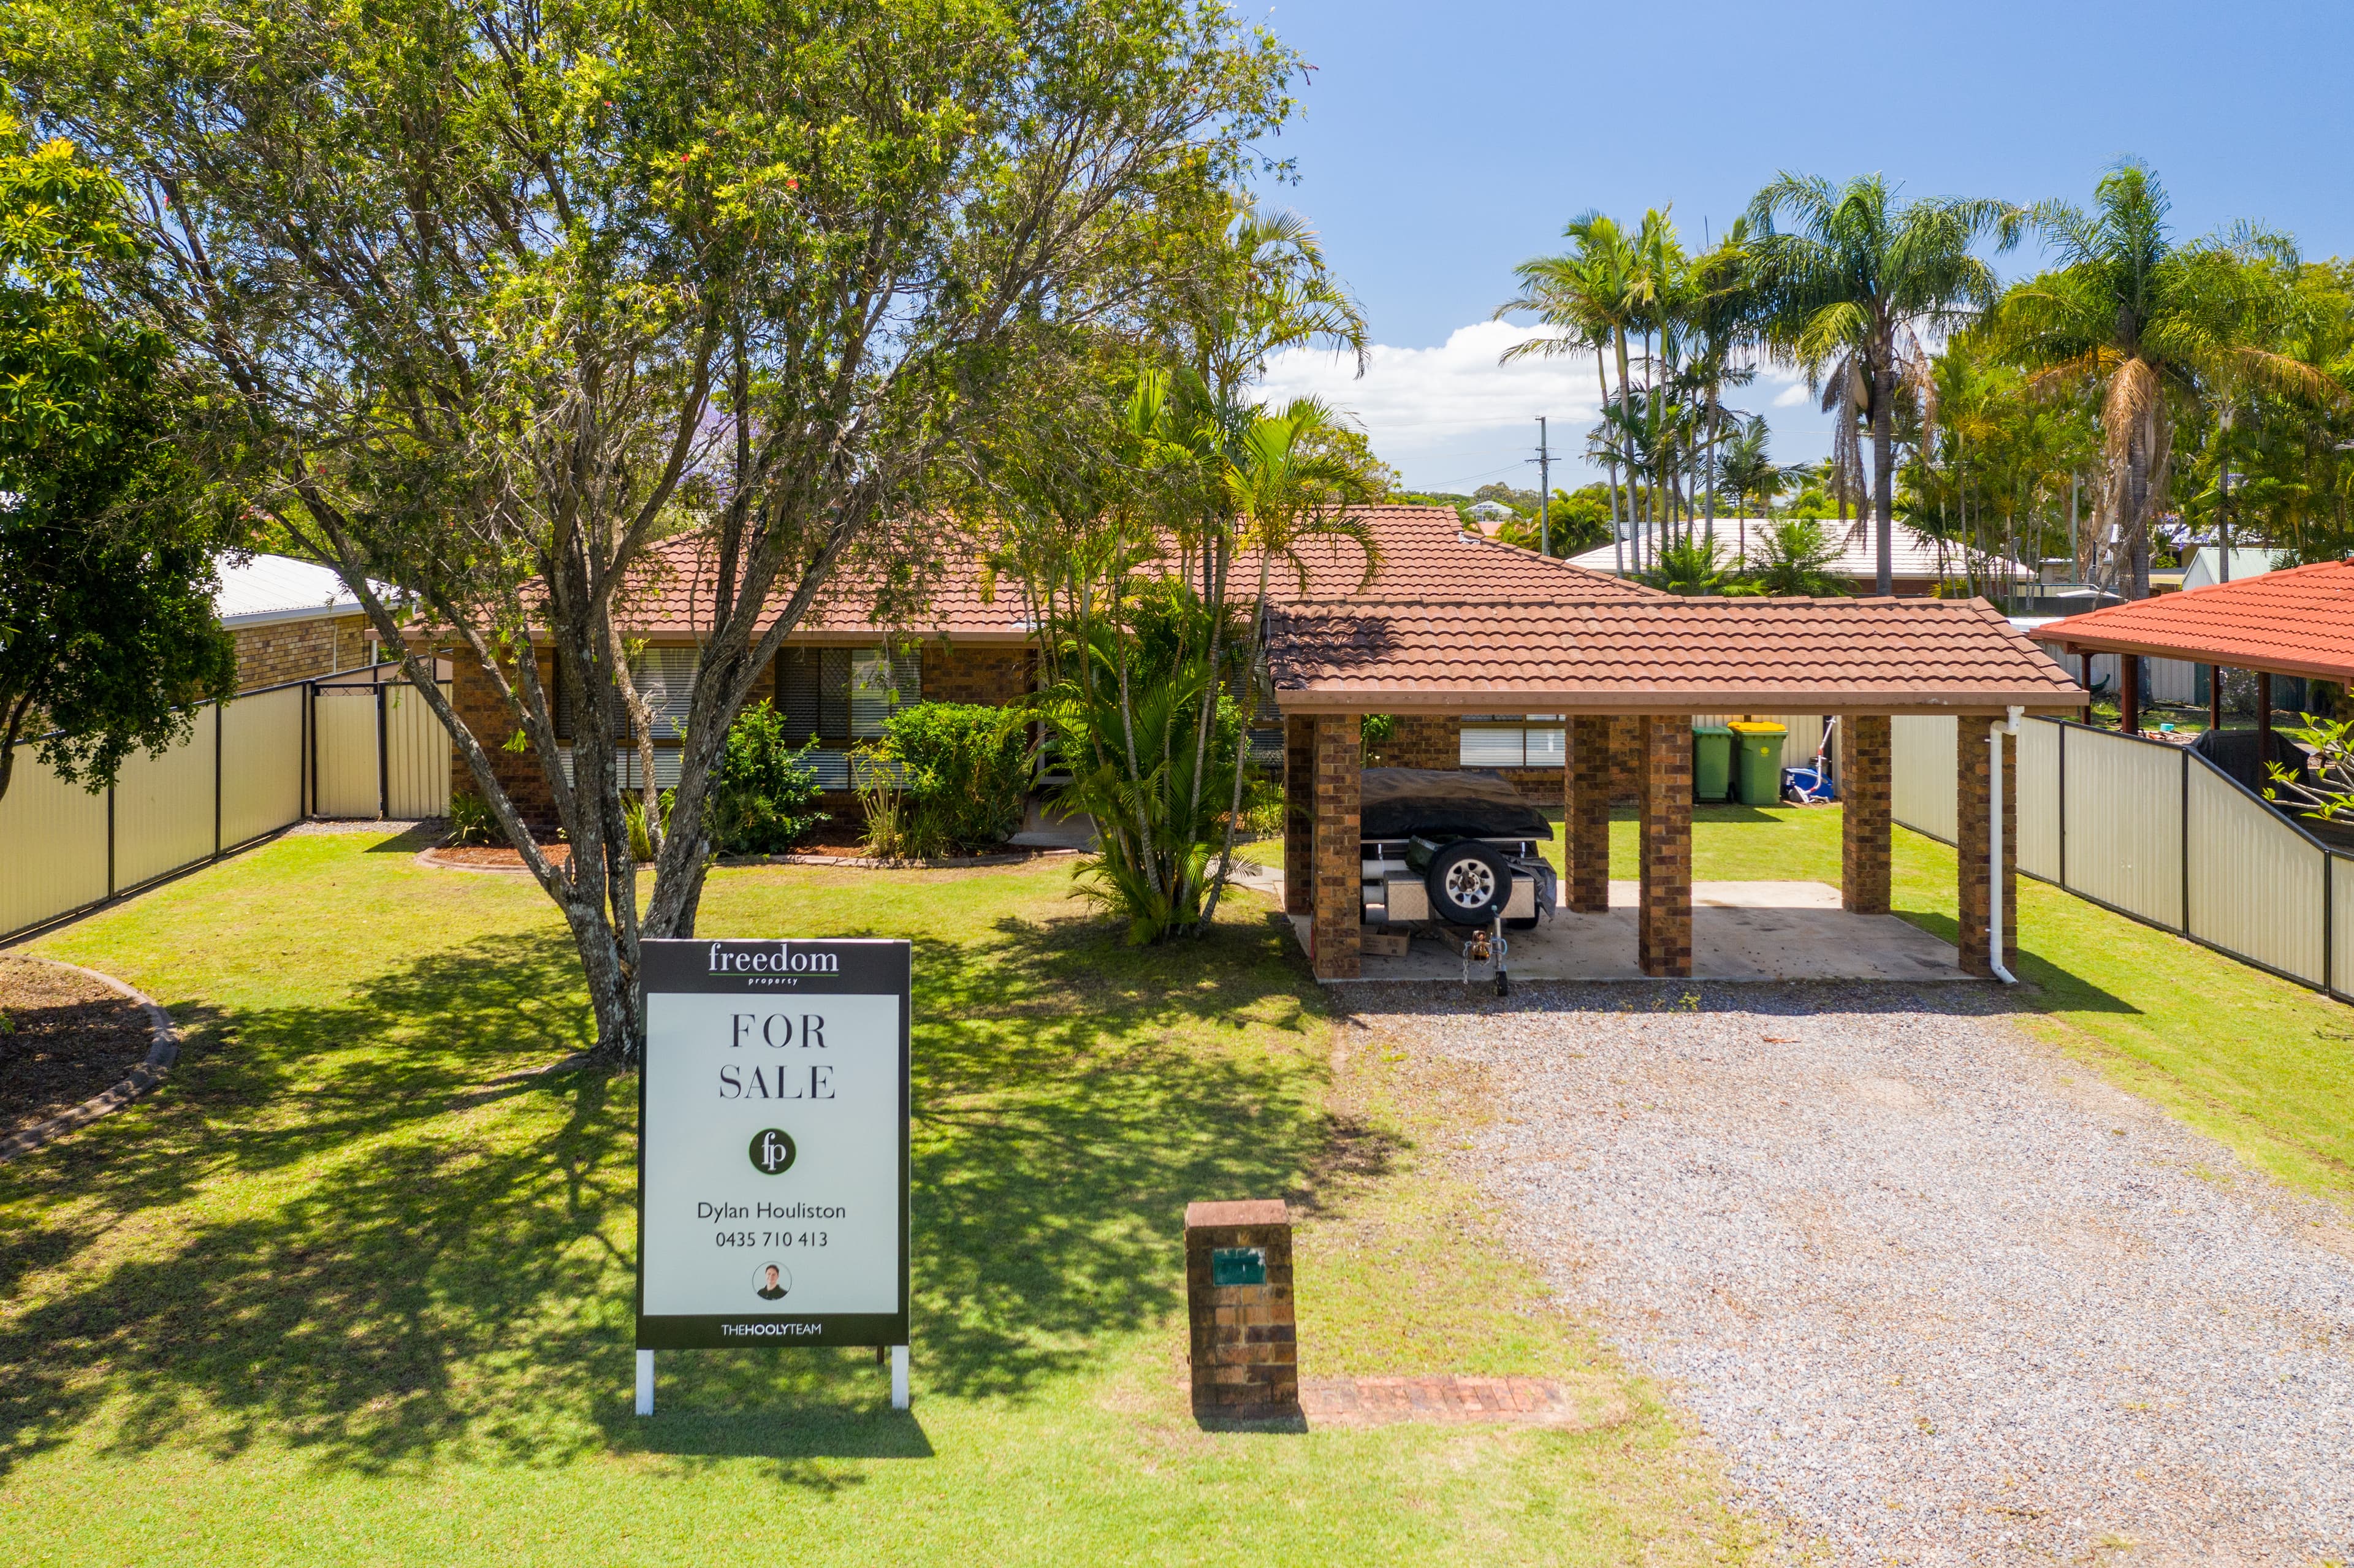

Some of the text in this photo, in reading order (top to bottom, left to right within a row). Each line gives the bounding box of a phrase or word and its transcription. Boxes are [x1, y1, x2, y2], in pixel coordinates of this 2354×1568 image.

[709, 943, 839, 972] freedom
[748, 978, 798, 986] property
[729, 1014, 828, 1048] FOR
[719, 1065, 836, 1099] SALE
[698, 1201, 845, 1224] Dylan Houliston
[716, 1231, 828, 1247] 0435 710 413
